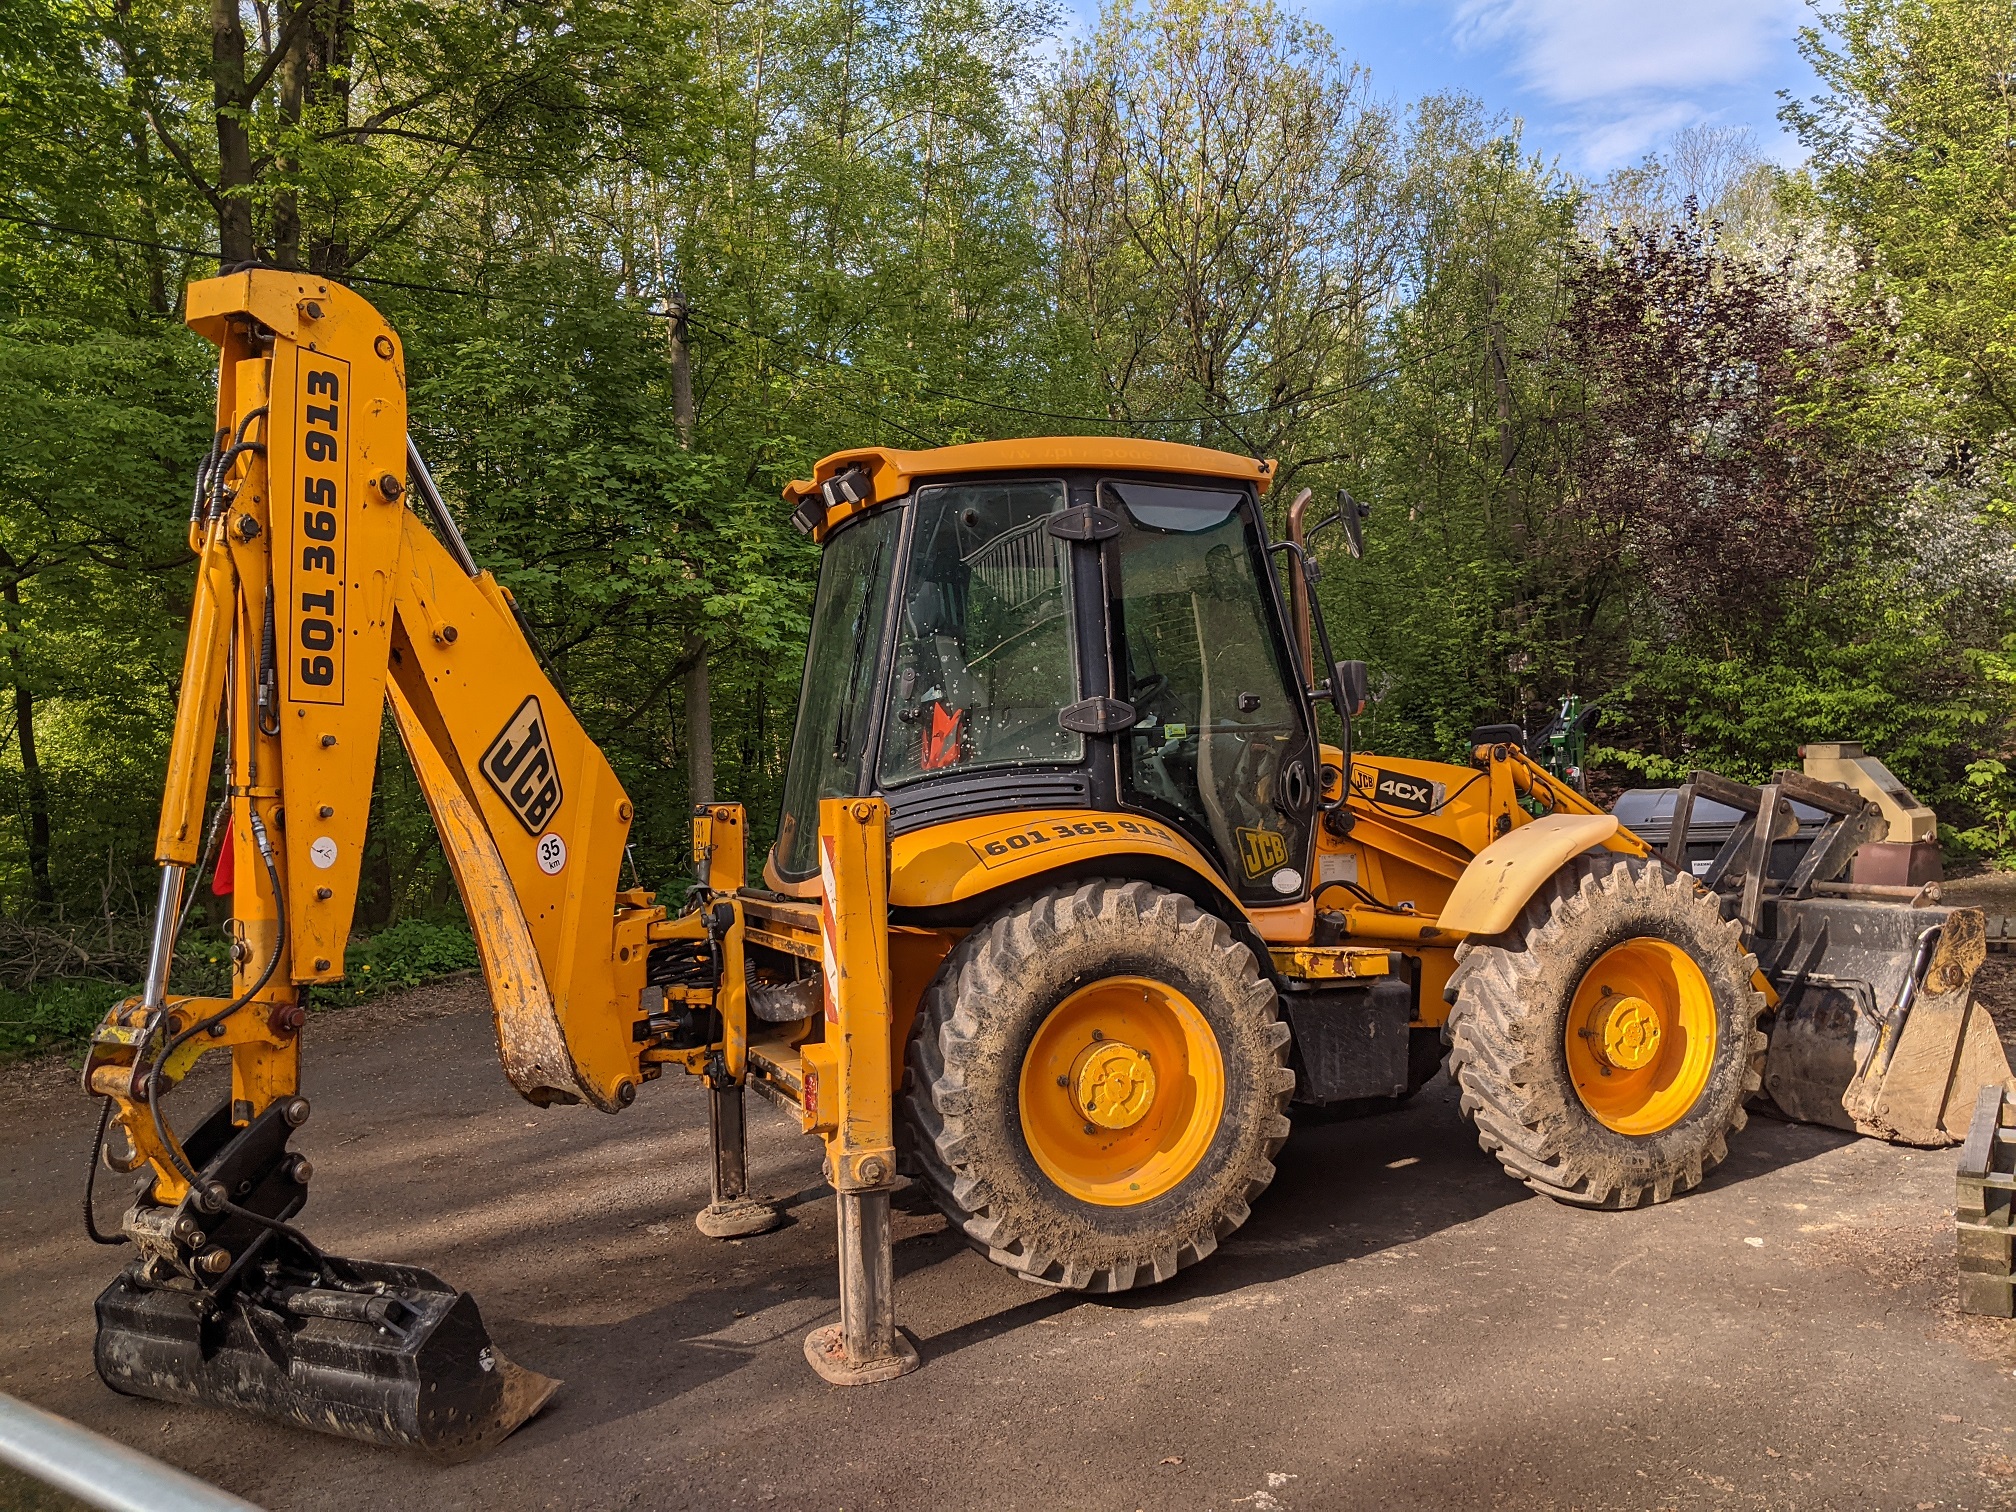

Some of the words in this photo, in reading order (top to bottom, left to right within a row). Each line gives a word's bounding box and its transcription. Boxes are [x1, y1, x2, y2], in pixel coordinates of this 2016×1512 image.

[305, 371, 339, 462] 913
[303, 477, 336, 575] 365
[301, 589, 334, 687] 601
[491, 718, 557, 827] JCB
[1357, 772, 1374, 789] JCB
[1380, 780, 1428, 804] 4CX
[541, 838, 560, 861] 35
[984, 830, 1050, 856] 601
[1052, 821, 1116, 839] 365
[1117, 820, 1173, 842] 913
[1245, 832, 1285, 873] JCB
[549, 859, 561, 869] km
